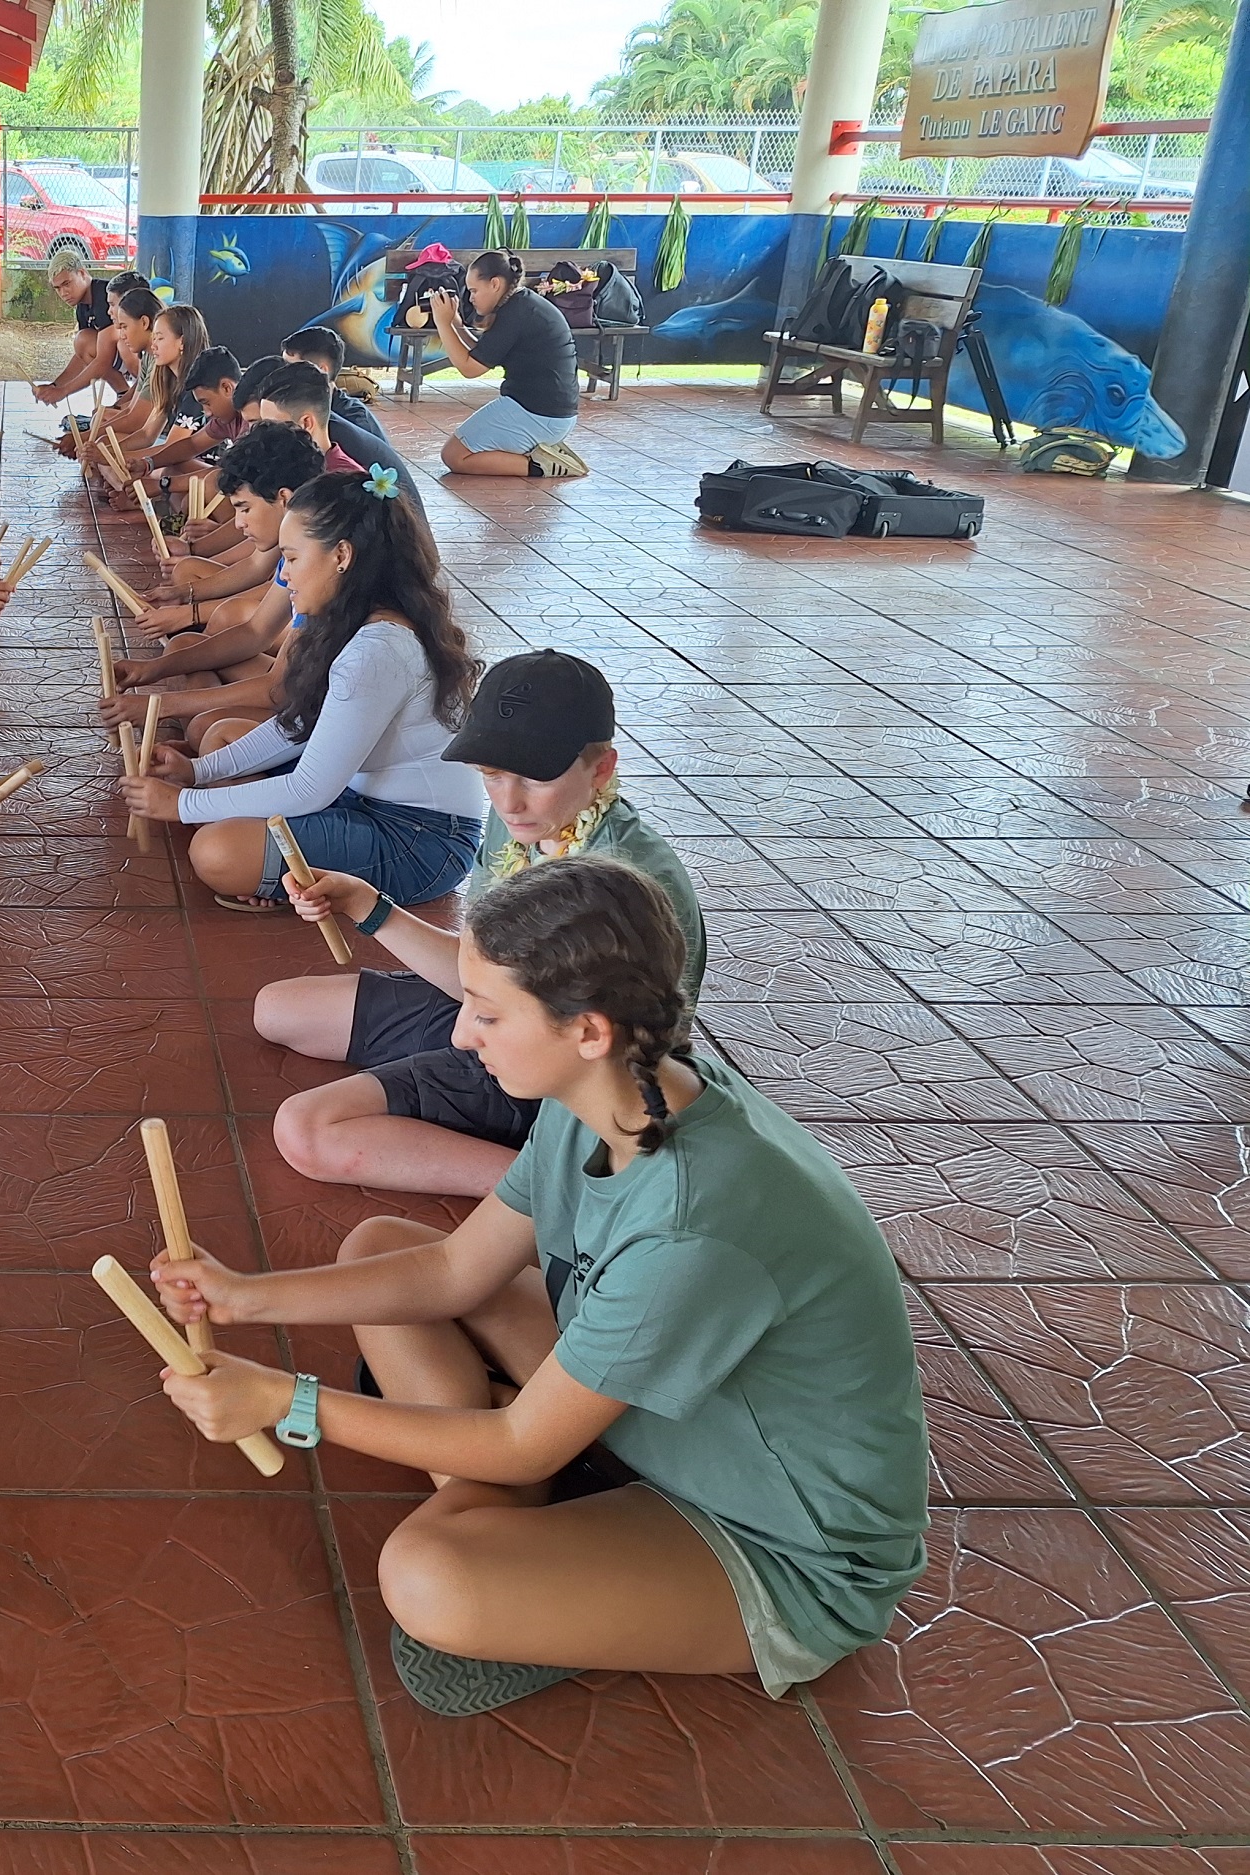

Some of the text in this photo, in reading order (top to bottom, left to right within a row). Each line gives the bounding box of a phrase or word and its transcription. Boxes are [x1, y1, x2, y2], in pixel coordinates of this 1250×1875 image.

[972, 7, 1097, 60] POLYVALENT
[932, 56, 1057, 101] DE PAPARA
[920, 104, 1065, 140] Tuianu LE GAYIC
